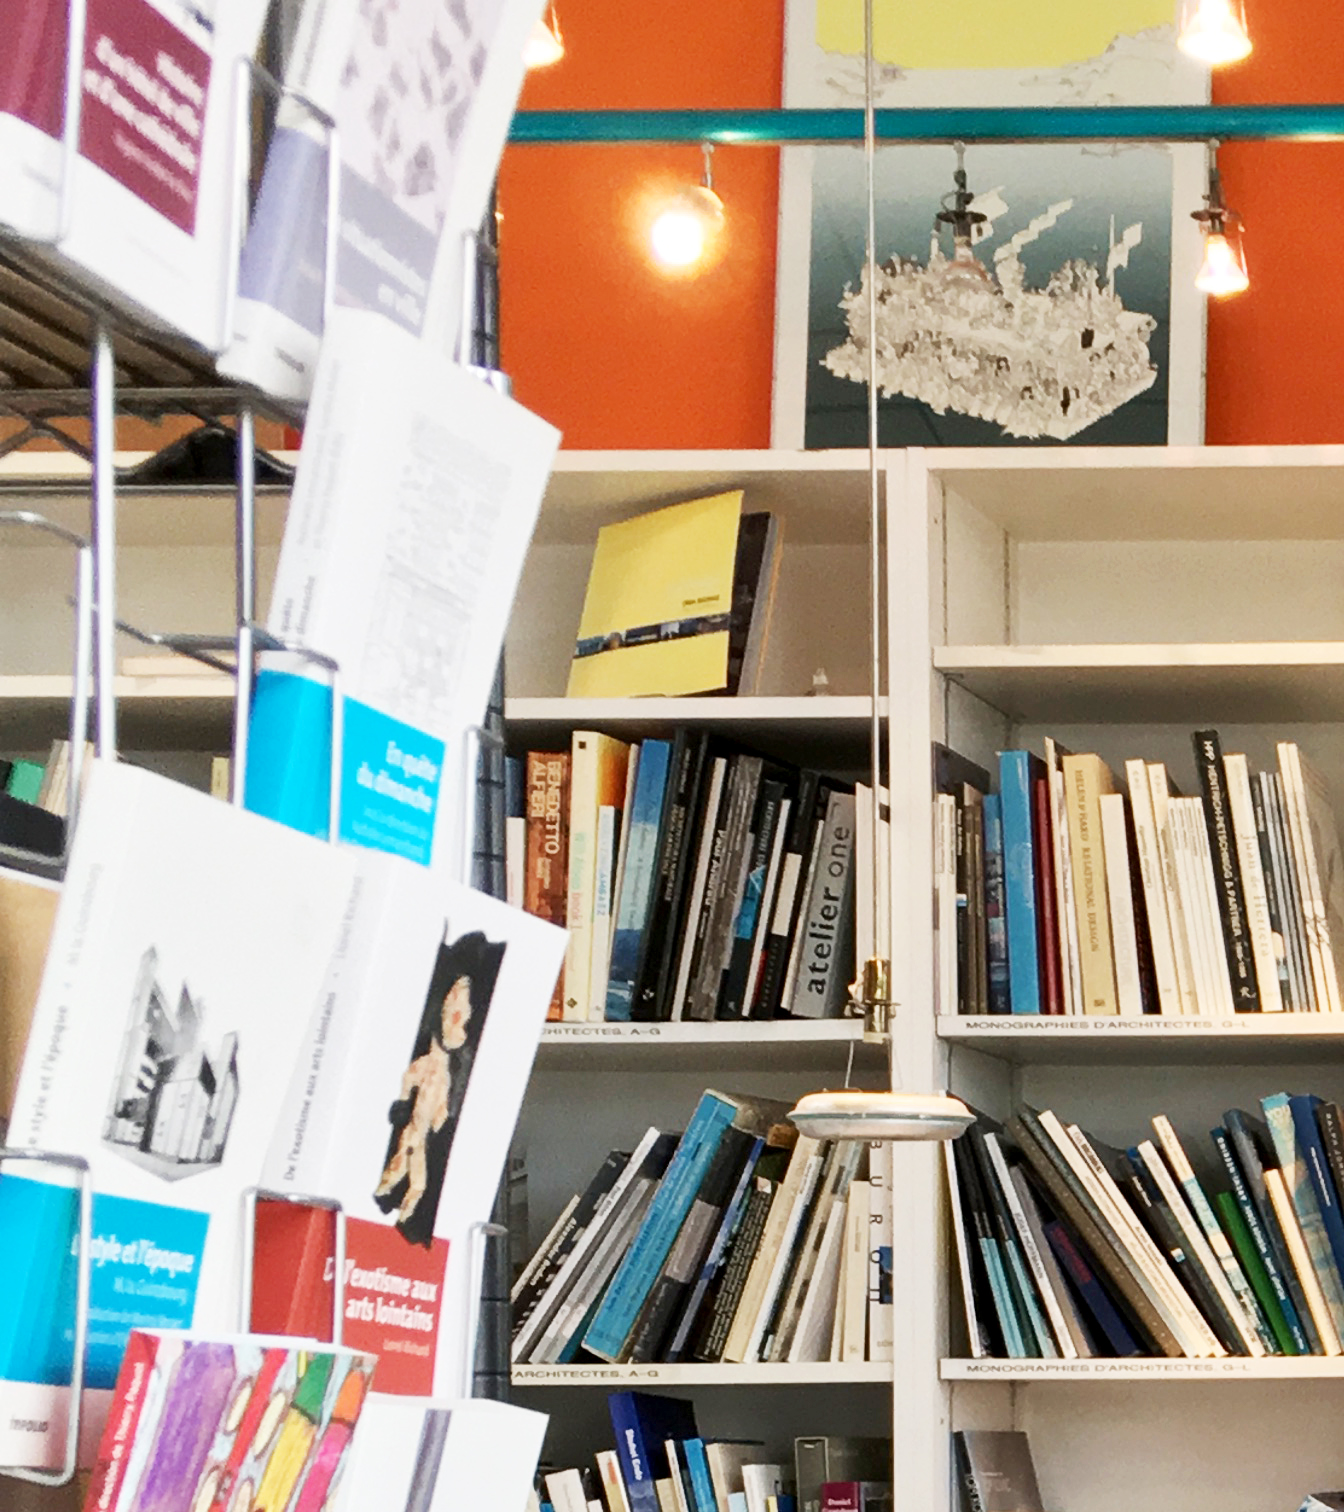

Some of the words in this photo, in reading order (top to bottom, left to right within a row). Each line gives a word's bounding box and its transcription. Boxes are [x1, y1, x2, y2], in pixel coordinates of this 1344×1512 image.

[544, 760, 562, 855] BENEDETTO
[807, 886, 840, 996] atelier
[828, 825, 850, 879] one
[345, 1297, 374, 1321] arts
[375, 1296, 434, 1332] lointains
